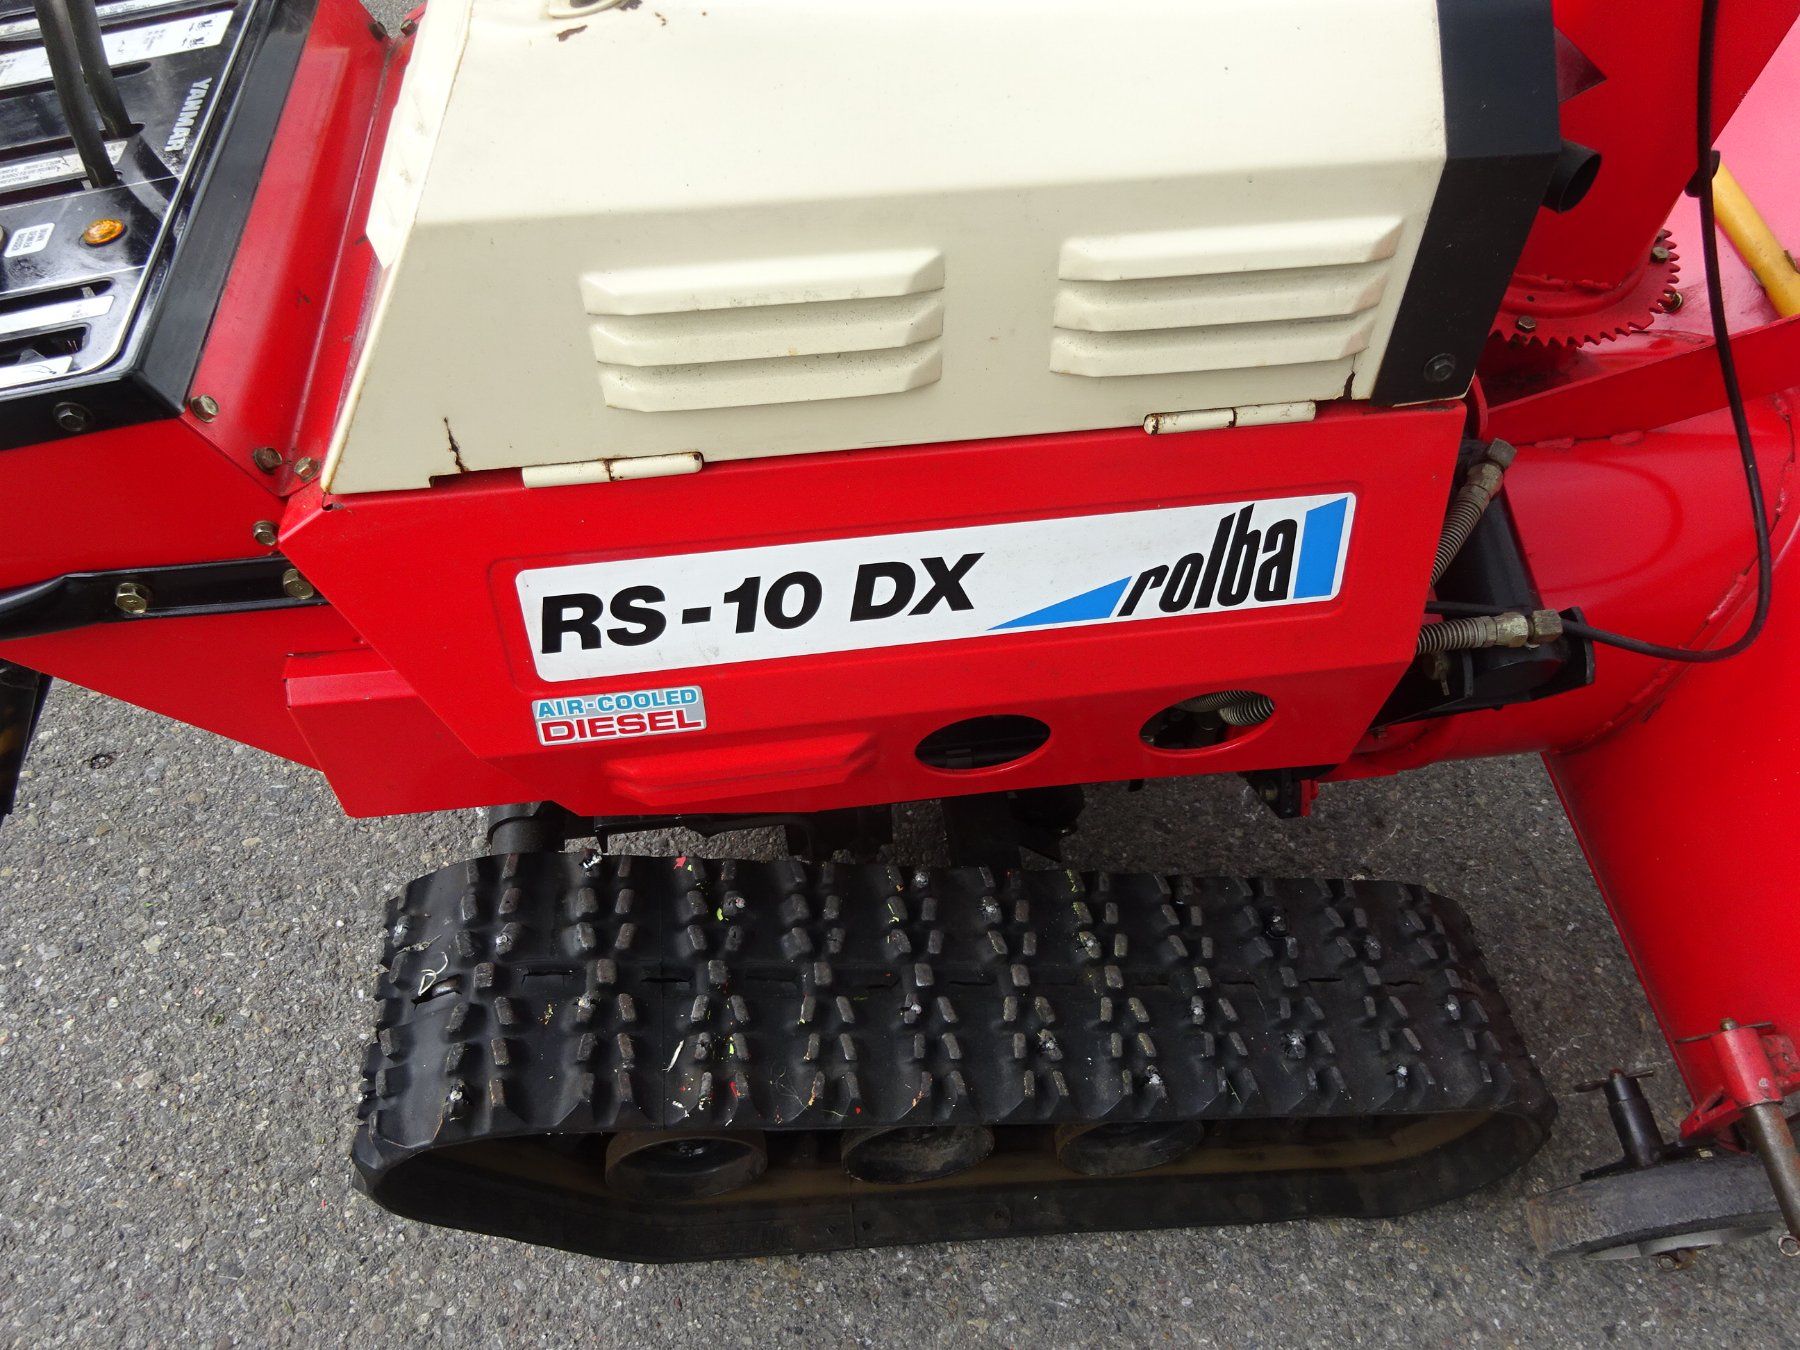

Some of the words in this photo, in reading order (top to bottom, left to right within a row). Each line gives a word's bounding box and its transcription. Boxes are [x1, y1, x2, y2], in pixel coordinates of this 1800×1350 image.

[164, 77, 213, 152] YANMAR
[850, 552, 986, 623] DX
[1117, 503, 1299, 617] rolba
[537, 687, 699, 719] AIR-COOLED
[539, 711, 704, 742] DIESEL
